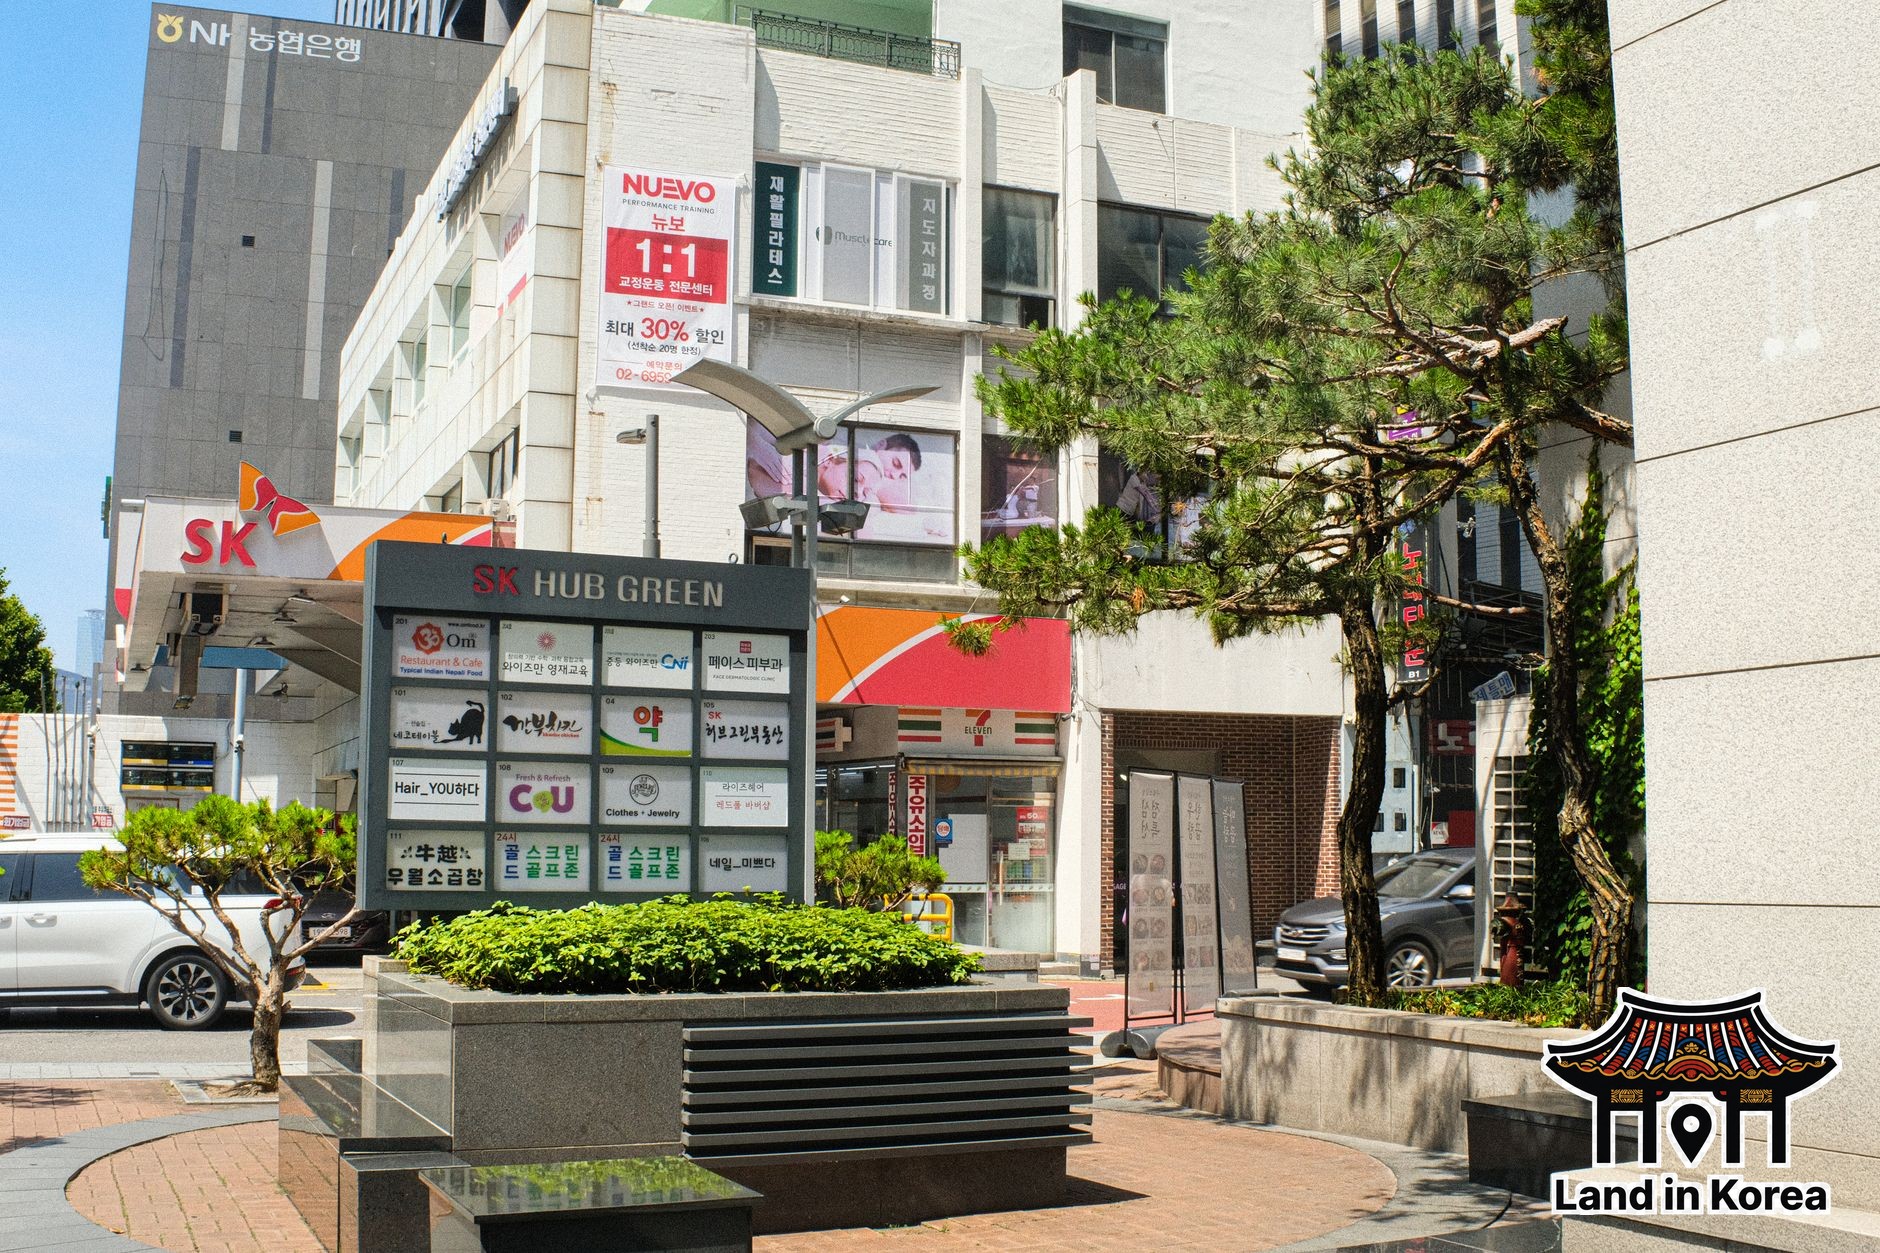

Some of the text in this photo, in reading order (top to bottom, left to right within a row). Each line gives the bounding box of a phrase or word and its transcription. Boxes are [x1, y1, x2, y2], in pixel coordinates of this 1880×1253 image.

[249, 27, 360, 62] 농협은행
[623, 173, 716, 204] NUEVO
[622, 198, 715, 214] PERFORMANCE TRAINING
[651, 214, 686, 232] 뉴보
[768, 175, 785, 285] 재활필라테스
[922, 199, 936, 300] 지도자과정
[634, 238, 697, 278] 1:1
[619, 275, 713, 296] 교정운동 전문센터
[632, 300, 699, 313] 그랜드 오픈! 이벤트
[605, 317, 724, 345] 최대 30% 할인
[660, 344, 678, 354] 20명
[646, 361, 683, 372] 예약문의
[180, 518, 258, 568] SK
[473, 565, 724, 608] SK HUB GREEN
[446, 634, 476, 648] Om
[400, 656, 483, 668] Restaurant & Cafe
[502, 662, 588, 678] 와이즈만 영재교육
[606, 656, 658, 669] 중등 와이즈만
[708, 656, 784, 672] 페이스 피부과
[1408, 670, 1420, 678] B1
[633, 706, 663, 742] 약
[708, 712, 722, 720] SK
[705, 722, 784, 744] 허브그린부동산
[606, 808, 638, 817] Clothes
[647, 810, 680, 819] Jewelry
[908, 776, 926, 858] 주유소입
[496, 832, 517, 841] 24시
[601, 834, 621, 843] 24시
[416, 844, 458, 863] 牛越
[526, 845, 580, 861] 스크린
[628, 846, 680, 862] 스크린
[504, 844, 520, 879] 골드
[608, 846, 622, 879] 골드
[710, 857, 776, 871] 네일_미쁘다
[388, 868, 484, 886] 우월소곱창
[526, 862, 580, 879] 골프존
[628, 863, 680, 879] 골프존
